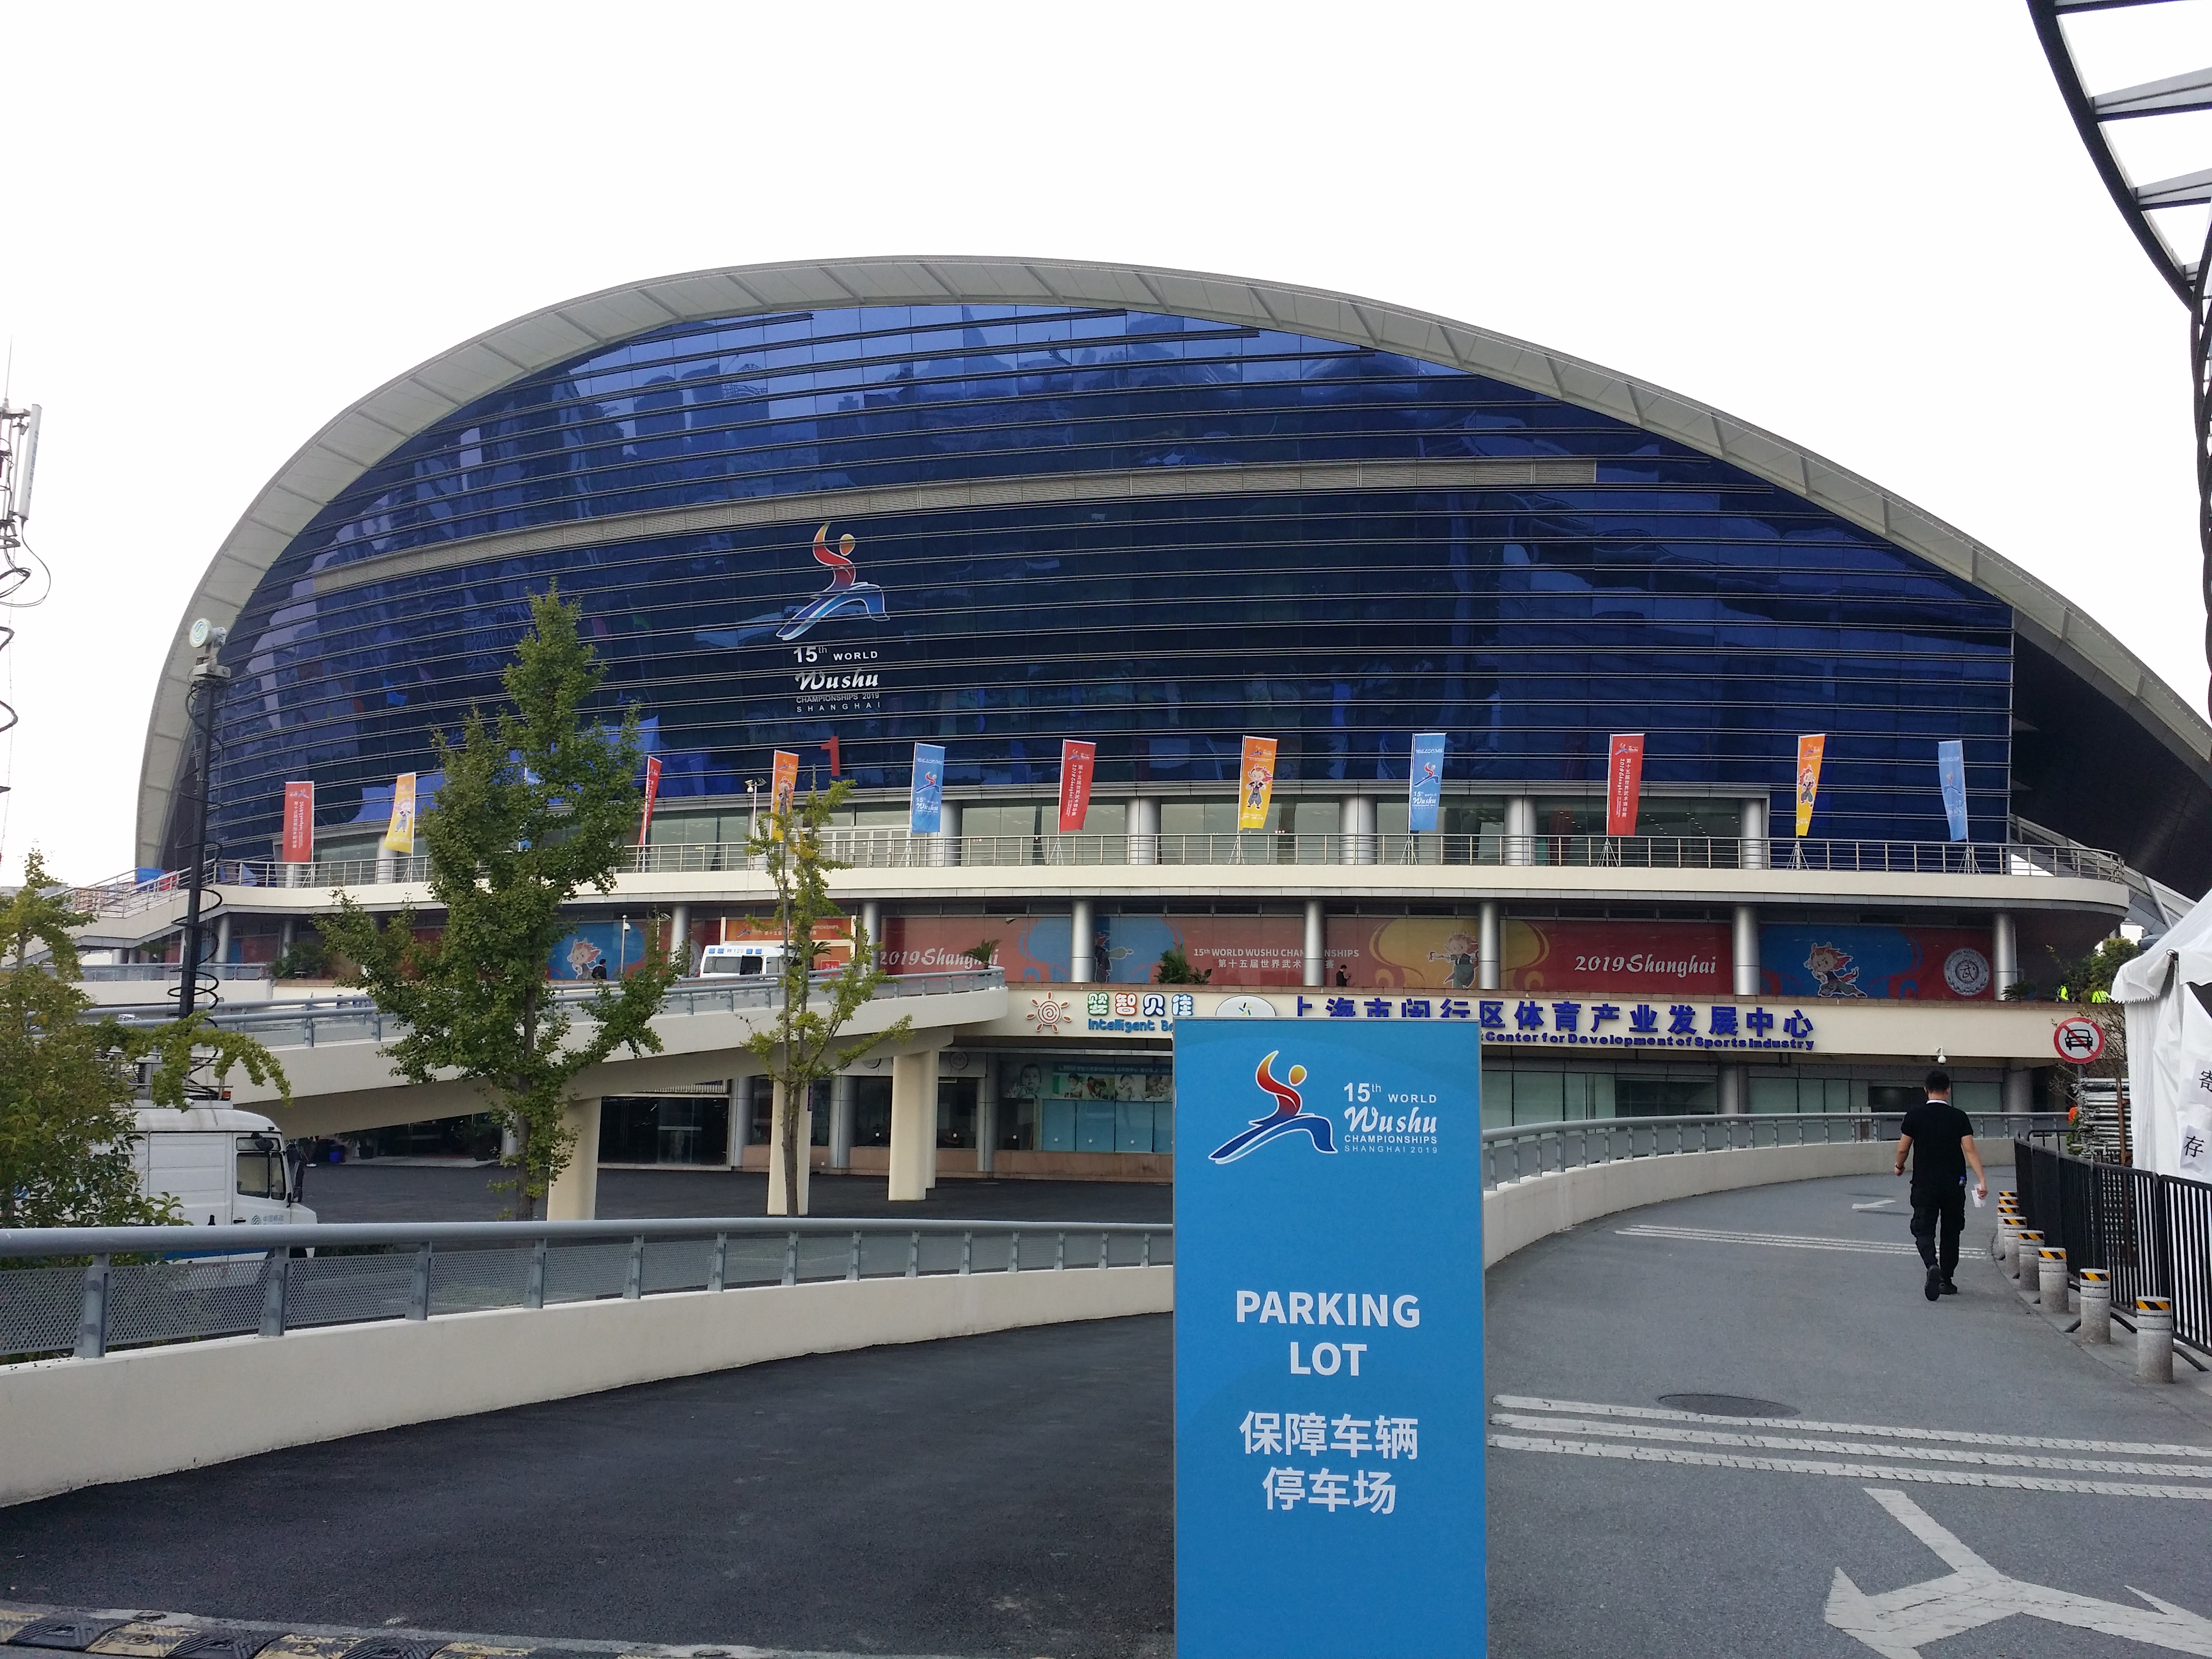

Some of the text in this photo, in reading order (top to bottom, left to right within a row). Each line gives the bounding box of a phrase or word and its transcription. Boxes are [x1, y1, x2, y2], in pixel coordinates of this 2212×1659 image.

[793, 646, 878, 663] 15th WORLD
[795, 669, 879, 691] Wushu
[796, 694, 858, 704] CHAMPIONSHIPS
[796, 703, 880, 713] SHANGHAI
[916, 803, 938, 811] Wushu
[1212, 948, 1244, 956] WORLD
[1245, 948, 1278, 957] WUSHU
[1218, 959, 1334, 969] 第十五届世界武术赛
[1088, 1018, 1155, 1033] Intelligent
[1297, 995, 1814, 1038] 上海市闵行区体育产业发展中心
[1485, 1031, 1538, 1042] Center
[1542, 1032, 1565, 1042] for
[1567, 1033, 1673, 1047] Development
[1676, 1036, 1692, 1046] of
[1694, 1036, 1747, 1049] Sports
[1748, 1038, 1814, 1050] Industry
[1343, 1082, 1437, 1103] 15th WORLD
[1343, 1107, 1437, 1134] Wushu
[1343, 1134, 1438, 1145] CHAMPIONSHIPS
[2184, 1135, 2204, 1159] 存
[1344, 1145, 1438, 1154] SHANGHAI 2019
[1236, 1290, 1421, 1328] PARKING
[1289, 1341, 1367, 1377] LOT
[1238, 1410, 1419, 1460] 保障车辆
[1262, 1466, 1396, 1515] 停车场
